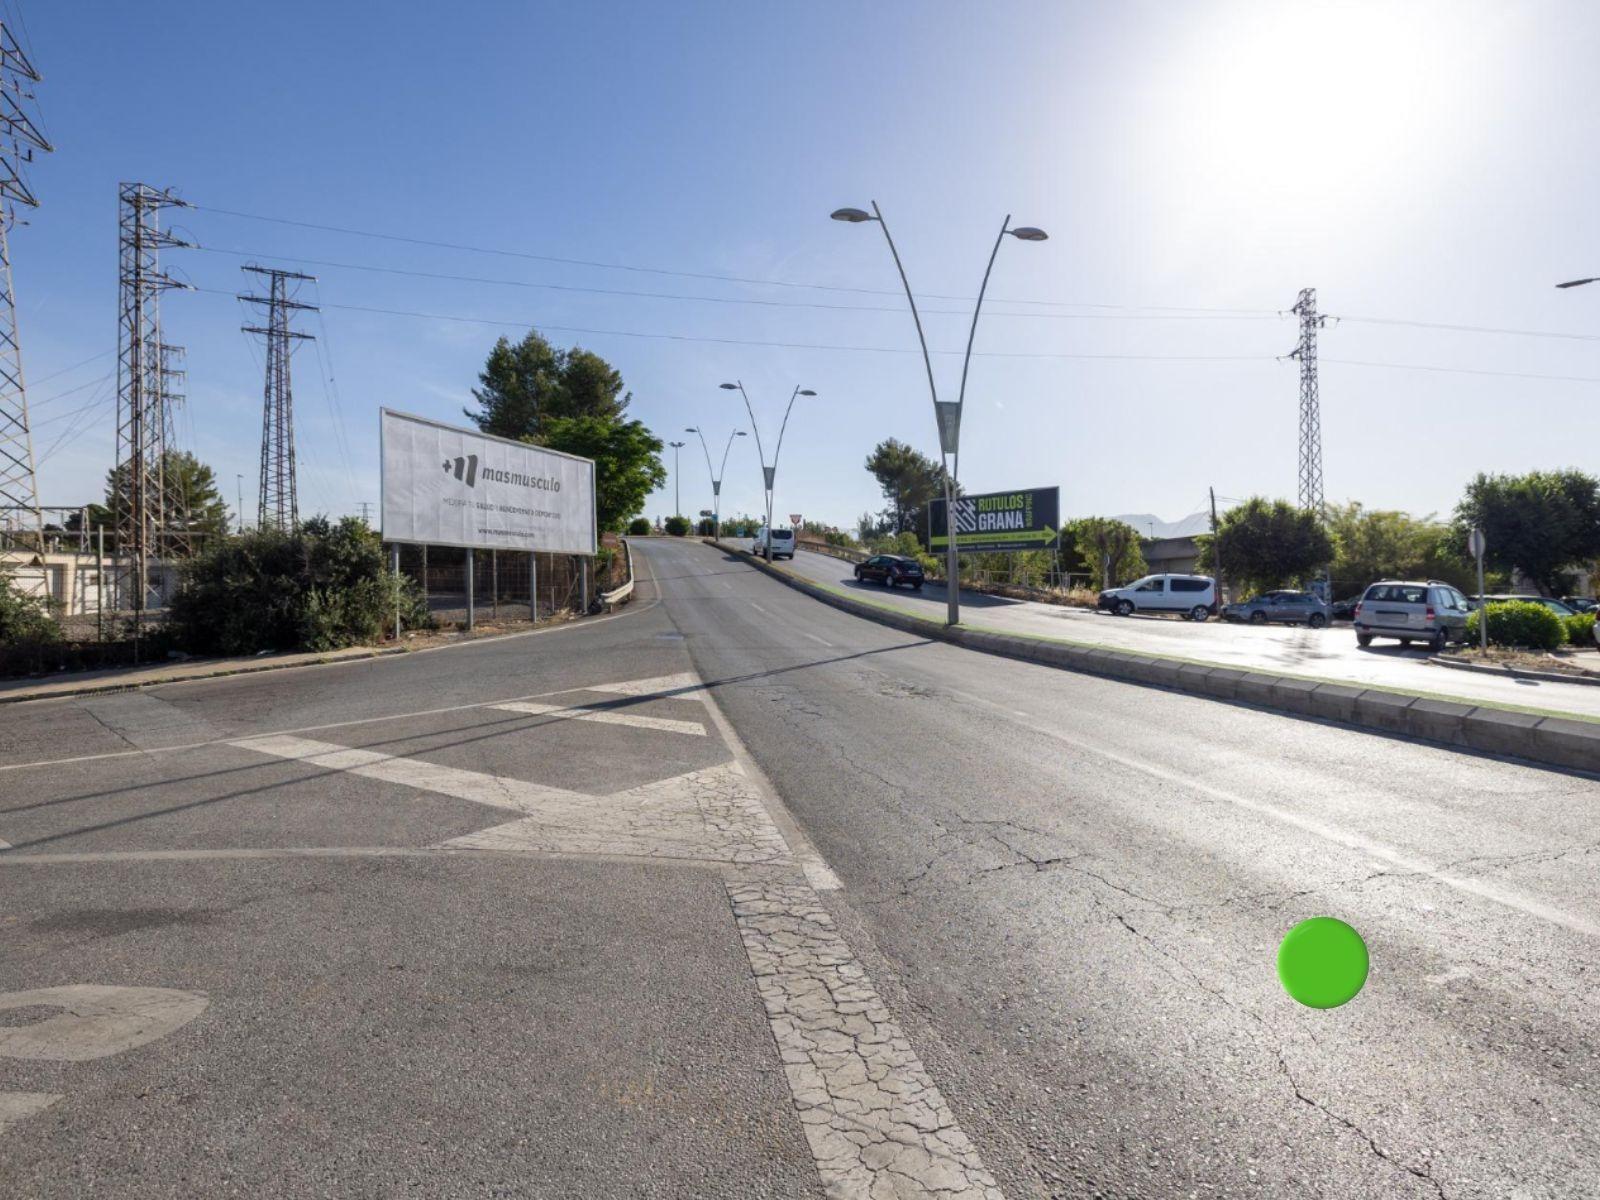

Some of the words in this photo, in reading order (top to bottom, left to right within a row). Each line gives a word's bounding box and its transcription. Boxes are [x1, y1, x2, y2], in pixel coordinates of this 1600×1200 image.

[482, 467, 561, 493] masmusculo
[978, 495, 1024, 512] ROTULOS
[978, 510, 1024, 530] GRANA
